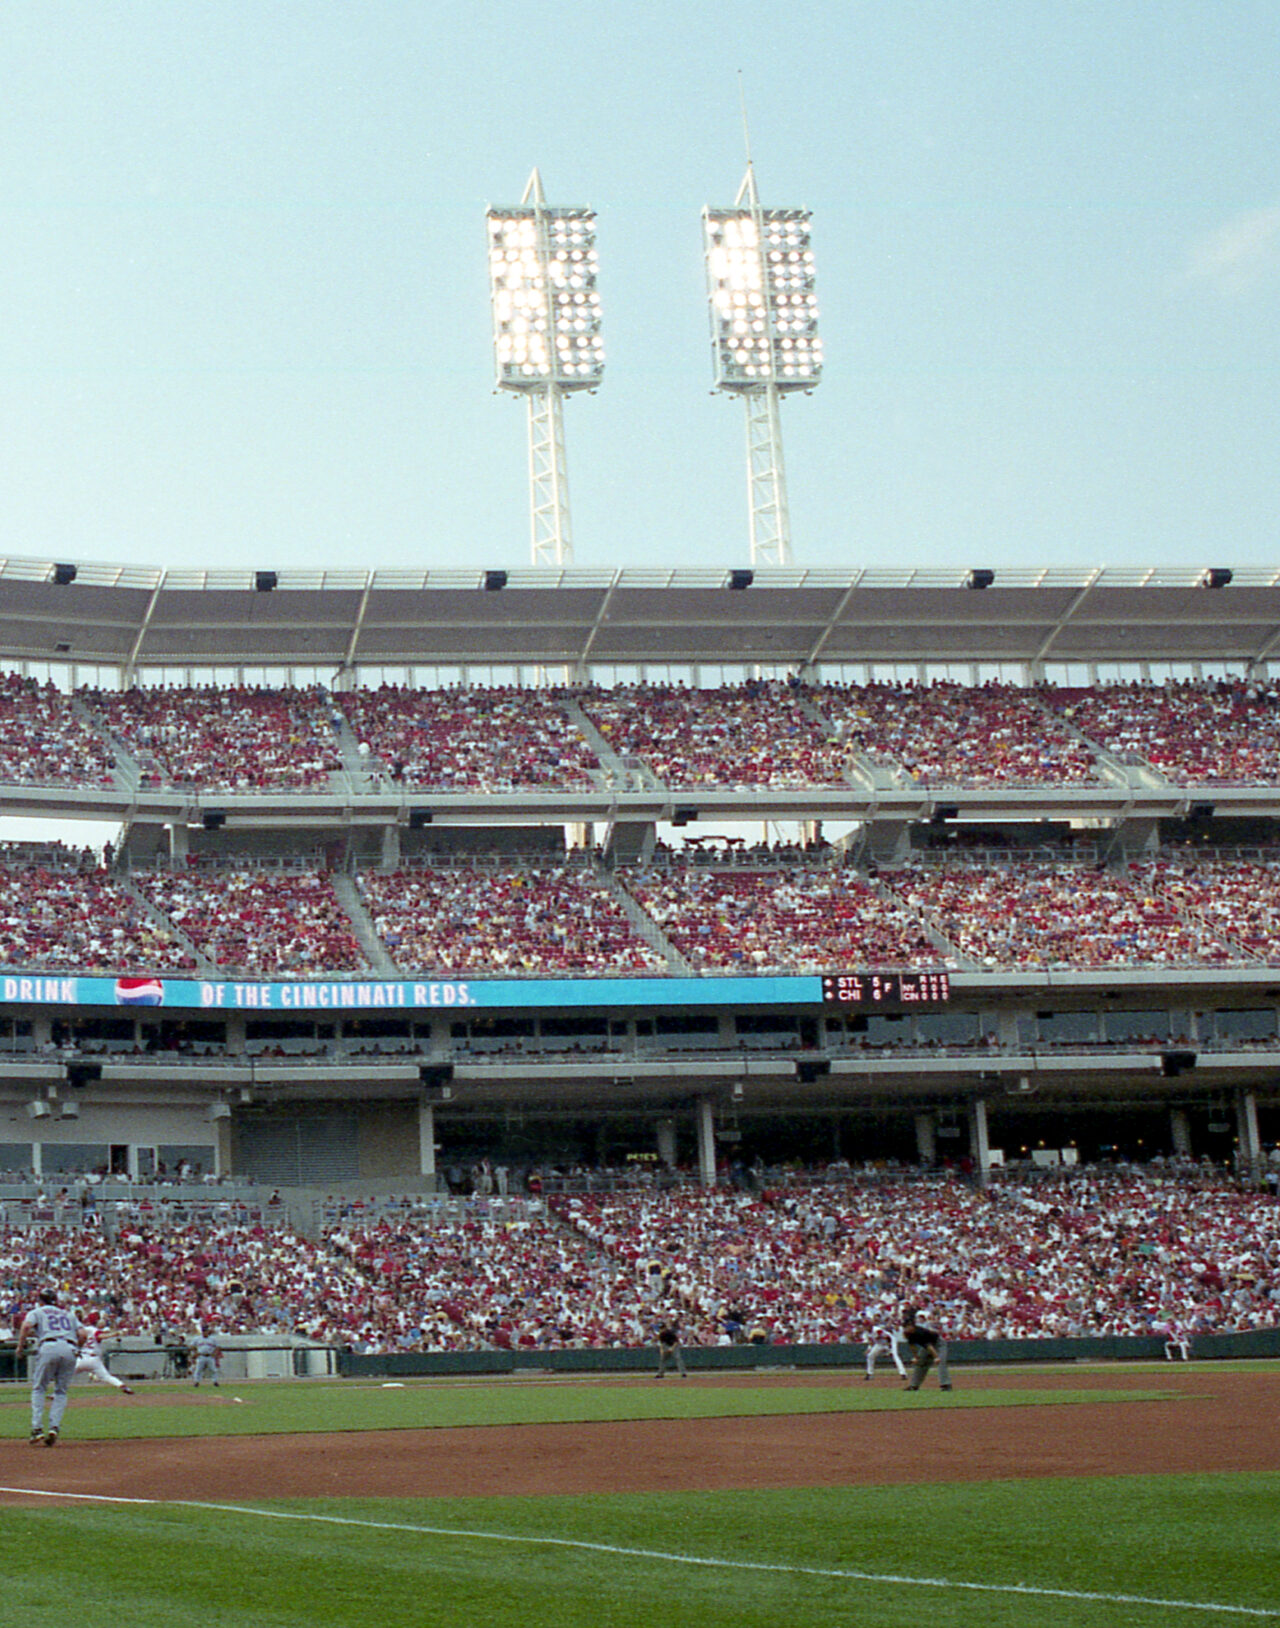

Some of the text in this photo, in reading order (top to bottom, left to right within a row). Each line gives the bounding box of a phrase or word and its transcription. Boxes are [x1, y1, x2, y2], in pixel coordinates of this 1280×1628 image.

[838, 977, 862, 988] STL
[884, 982, 892, 992] F
[4, 979, 75, 1002] DRINK
[202, 984, 226, 1006] OF
[234, 985, 271, 1006] THE
[280, 985, 405, 1006] CINCINNATI
[415, 984, 476, 1005] REDS.
[838, 990, 861, 1000] CHI
[47, 1315, 71, 1331] 20
